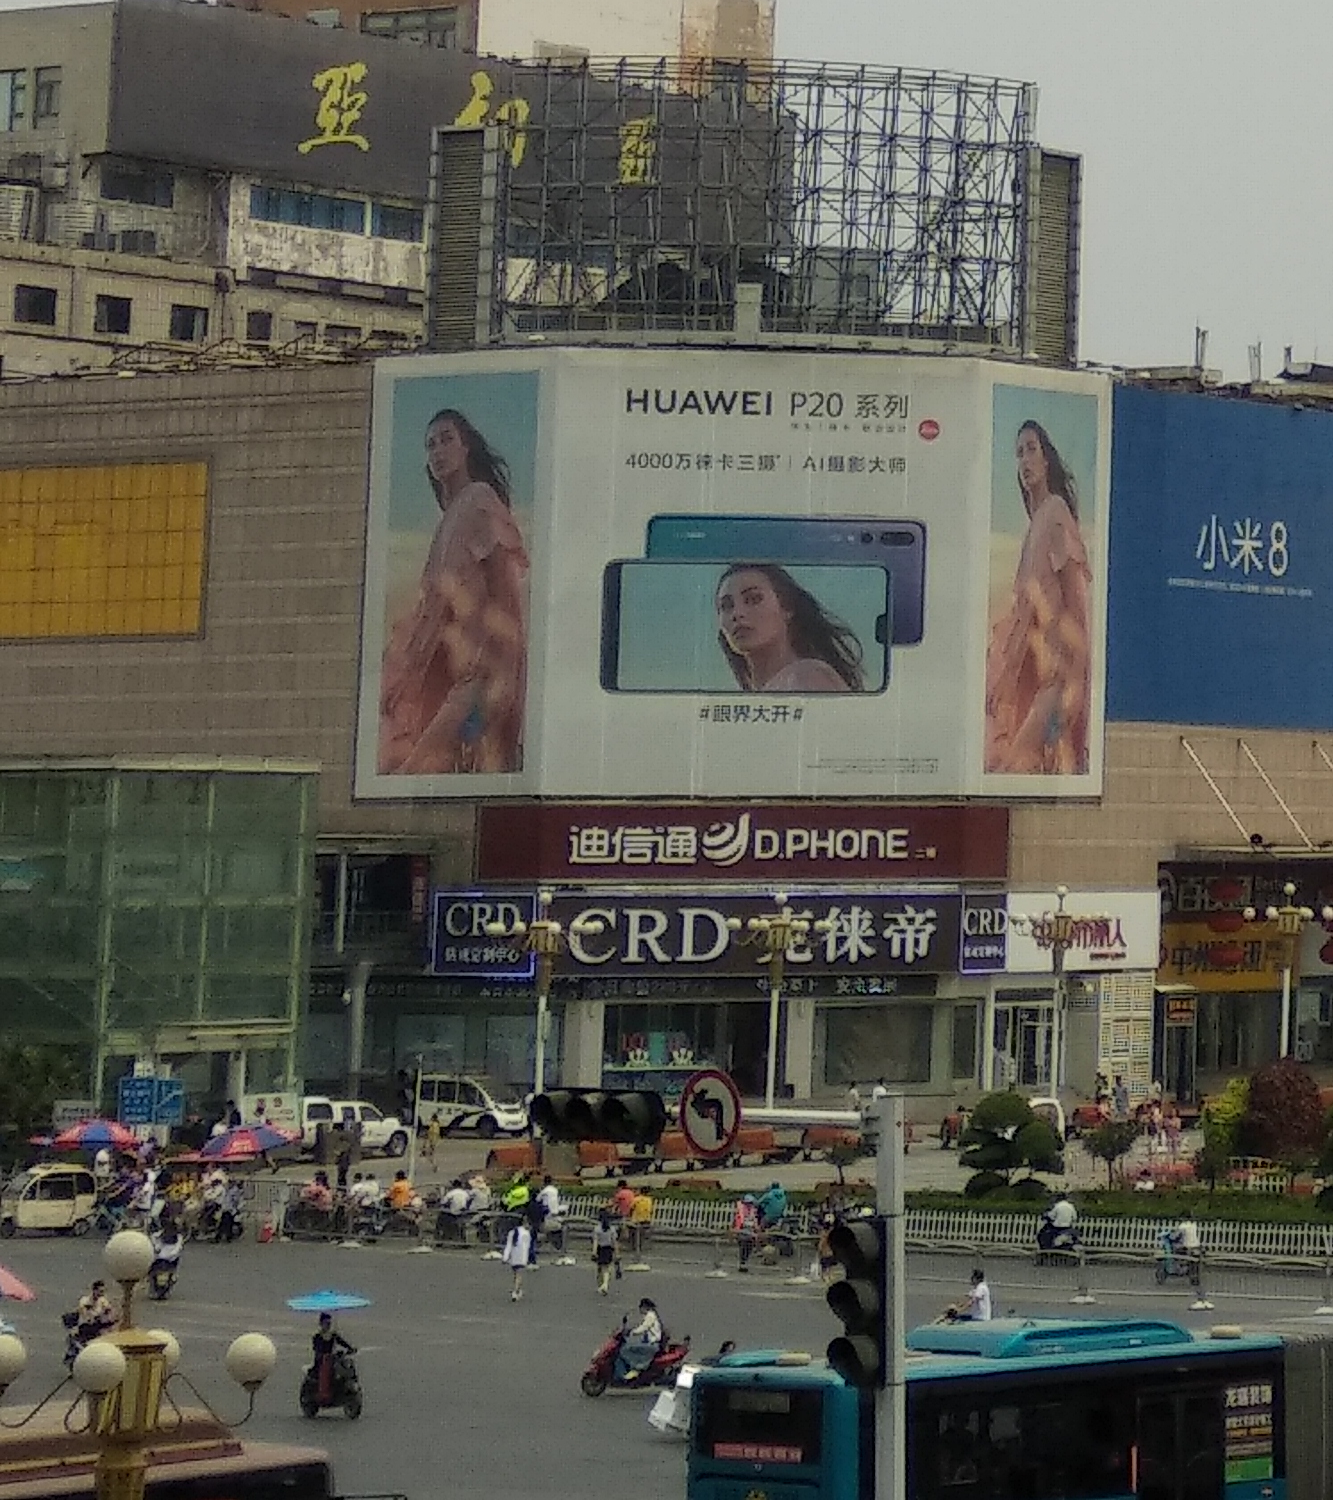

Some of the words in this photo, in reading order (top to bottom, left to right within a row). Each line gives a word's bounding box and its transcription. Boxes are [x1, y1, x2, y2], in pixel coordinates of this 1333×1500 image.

[625, 388, 772, 417] HUAWEI
[789, 391, 844, 418] P20
[855, 393, 909, 419] 系列
[1195, 513, 1289, 577] 小米8
[699, 704, 803, 723] #眼界大开#
[568, 825, 698, 865] 迪信通
[753, 828, 910, 861] D.PHONE
[444, 902, 522, 937] CRD
[567, 907, 731, 965] CRD
[963, 907, 1009, 937] CRD
